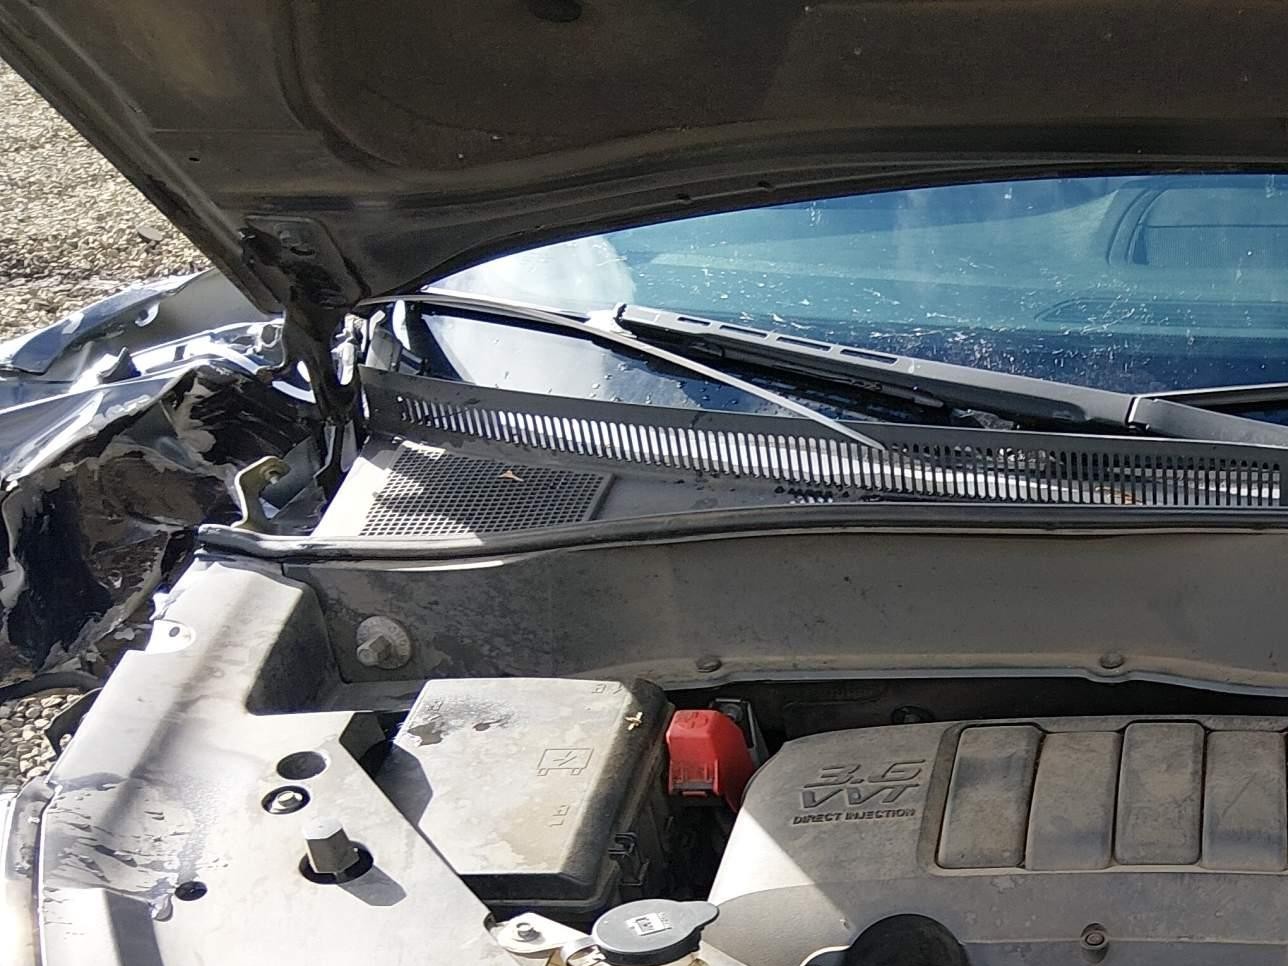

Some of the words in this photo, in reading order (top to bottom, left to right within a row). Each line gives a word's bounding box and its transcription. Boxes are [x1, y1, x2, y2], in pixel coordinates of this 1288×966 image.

[804, 760, 926, 788] 3.6
[802, 784, 920, 809] VVT
[792, 811, 842, 825] DIRECT
[845, 809, 916, 821] INJECTION
